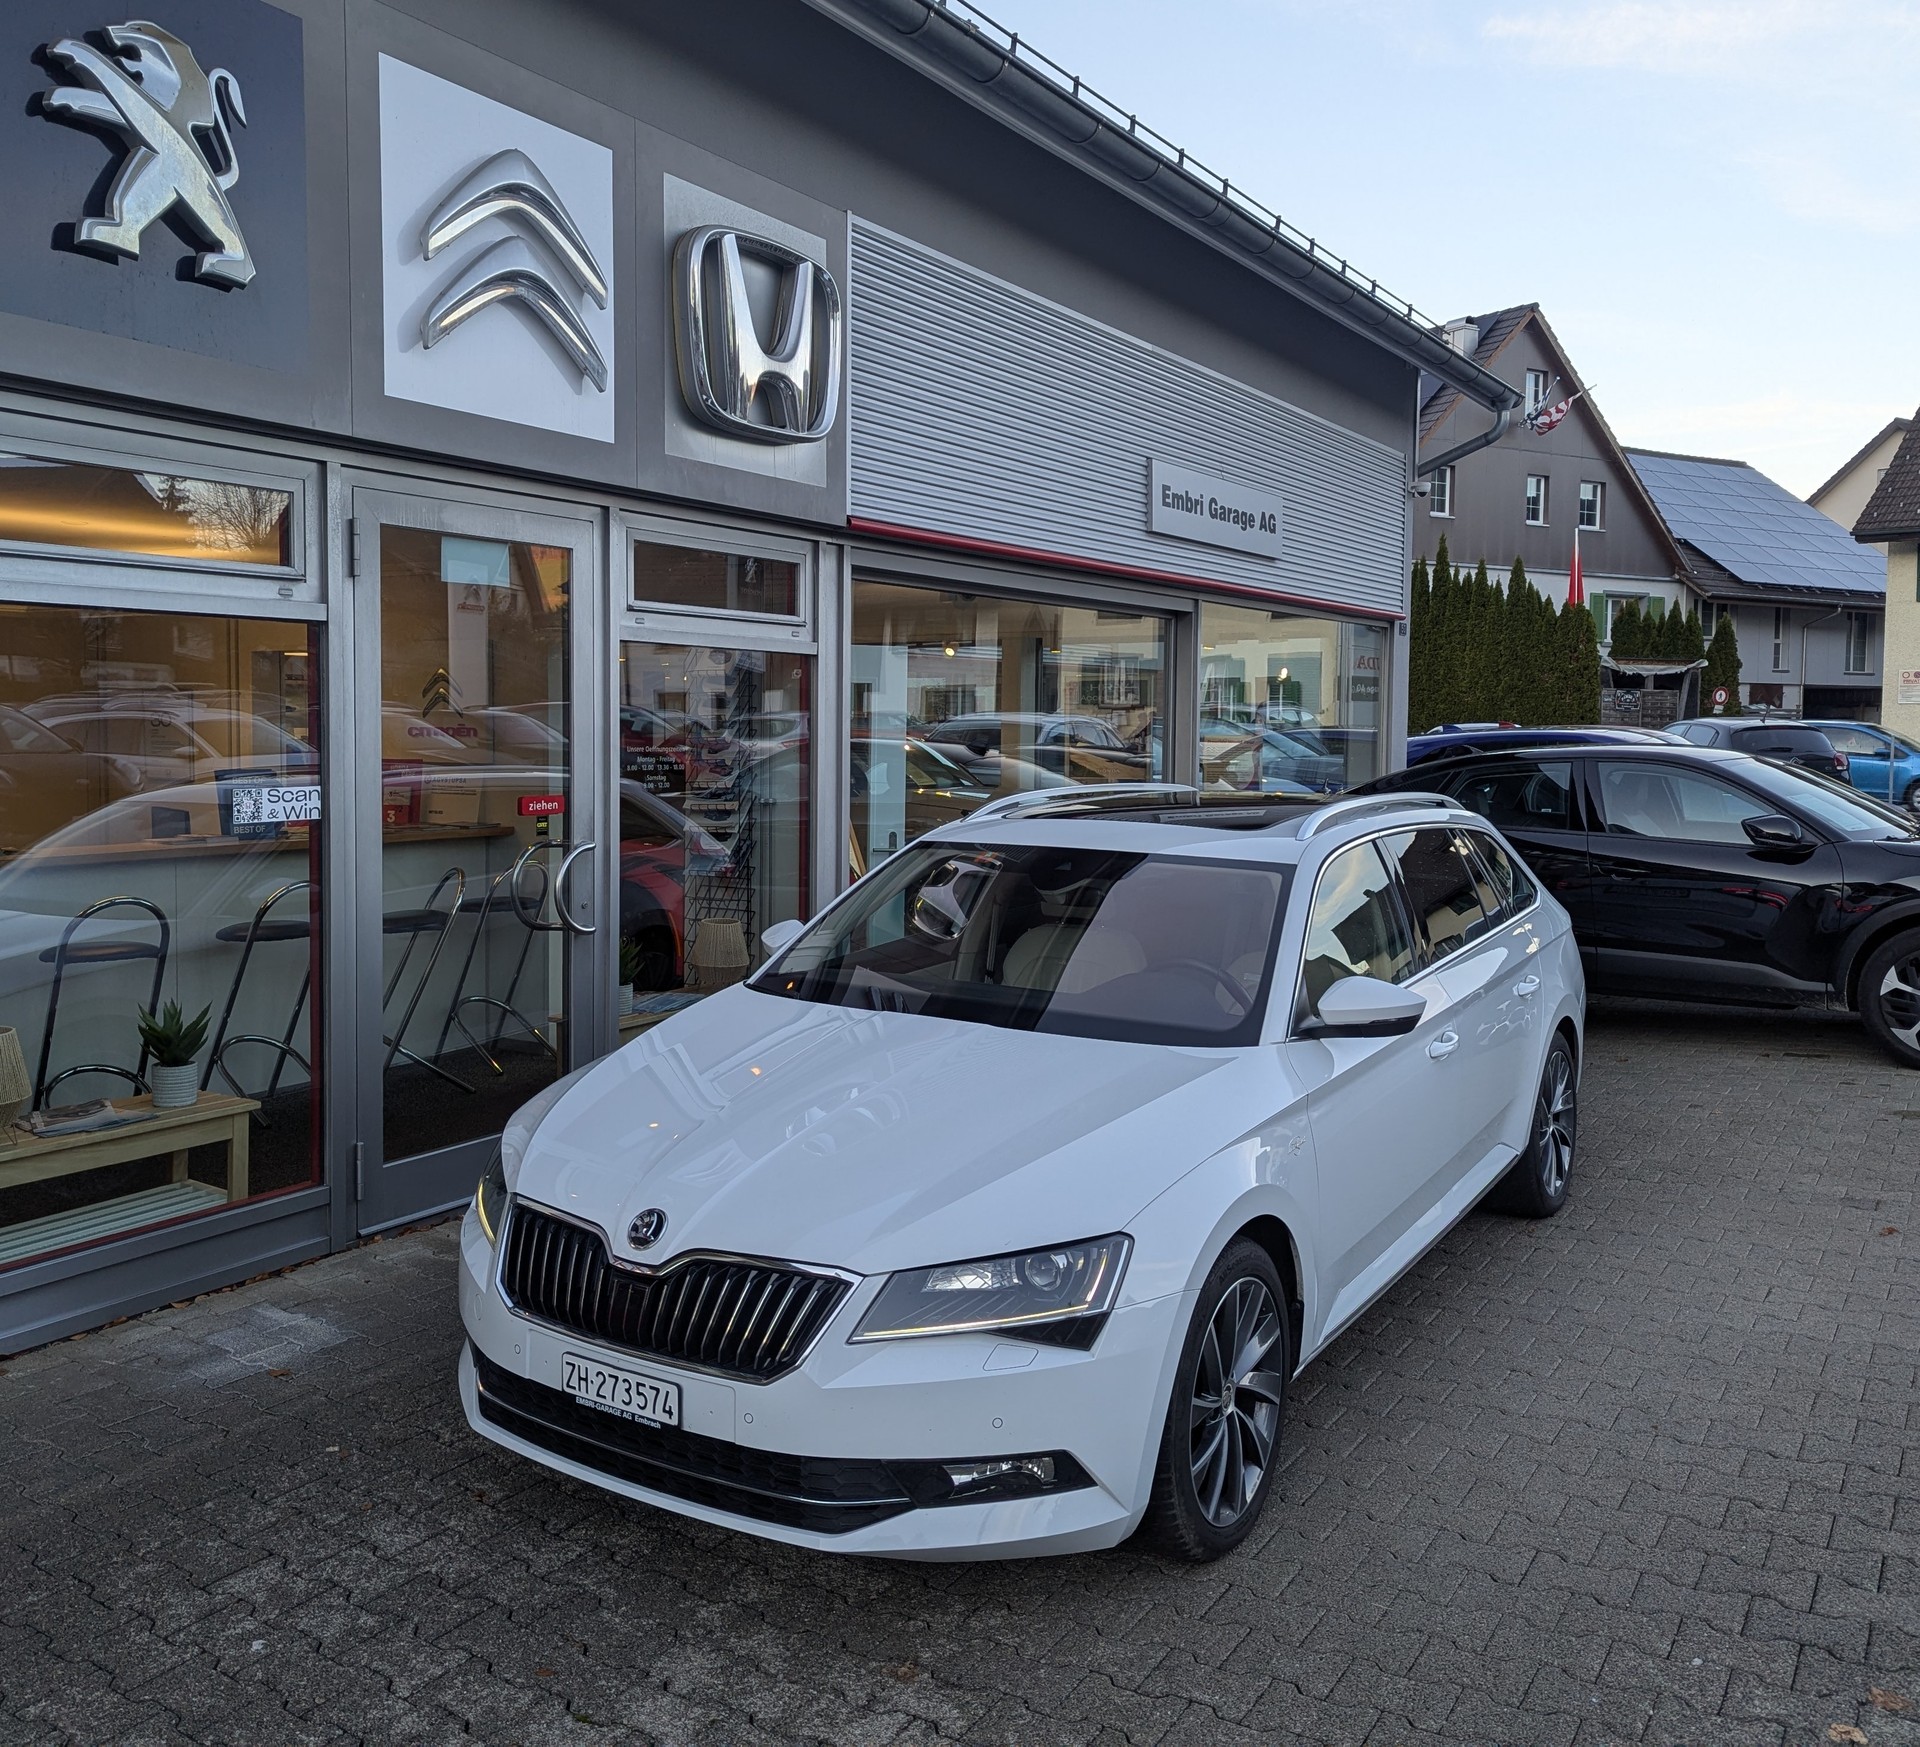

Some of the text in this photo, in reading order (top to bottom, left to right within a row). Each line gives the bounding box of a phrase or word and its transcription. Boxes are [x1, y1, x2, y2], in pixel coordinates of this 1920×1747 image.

[1161, 483, 1277, 535] Embri Garage AG
[267, 788, 321, 804] Scan
[267, 802, 321, 820] & Win
[528, 800, 559, 811] ziehen
[233, 825, 266, 834] BEST OF
[575, 1396, 661, 1429] EMBRI-GARAGE AG Embrach
